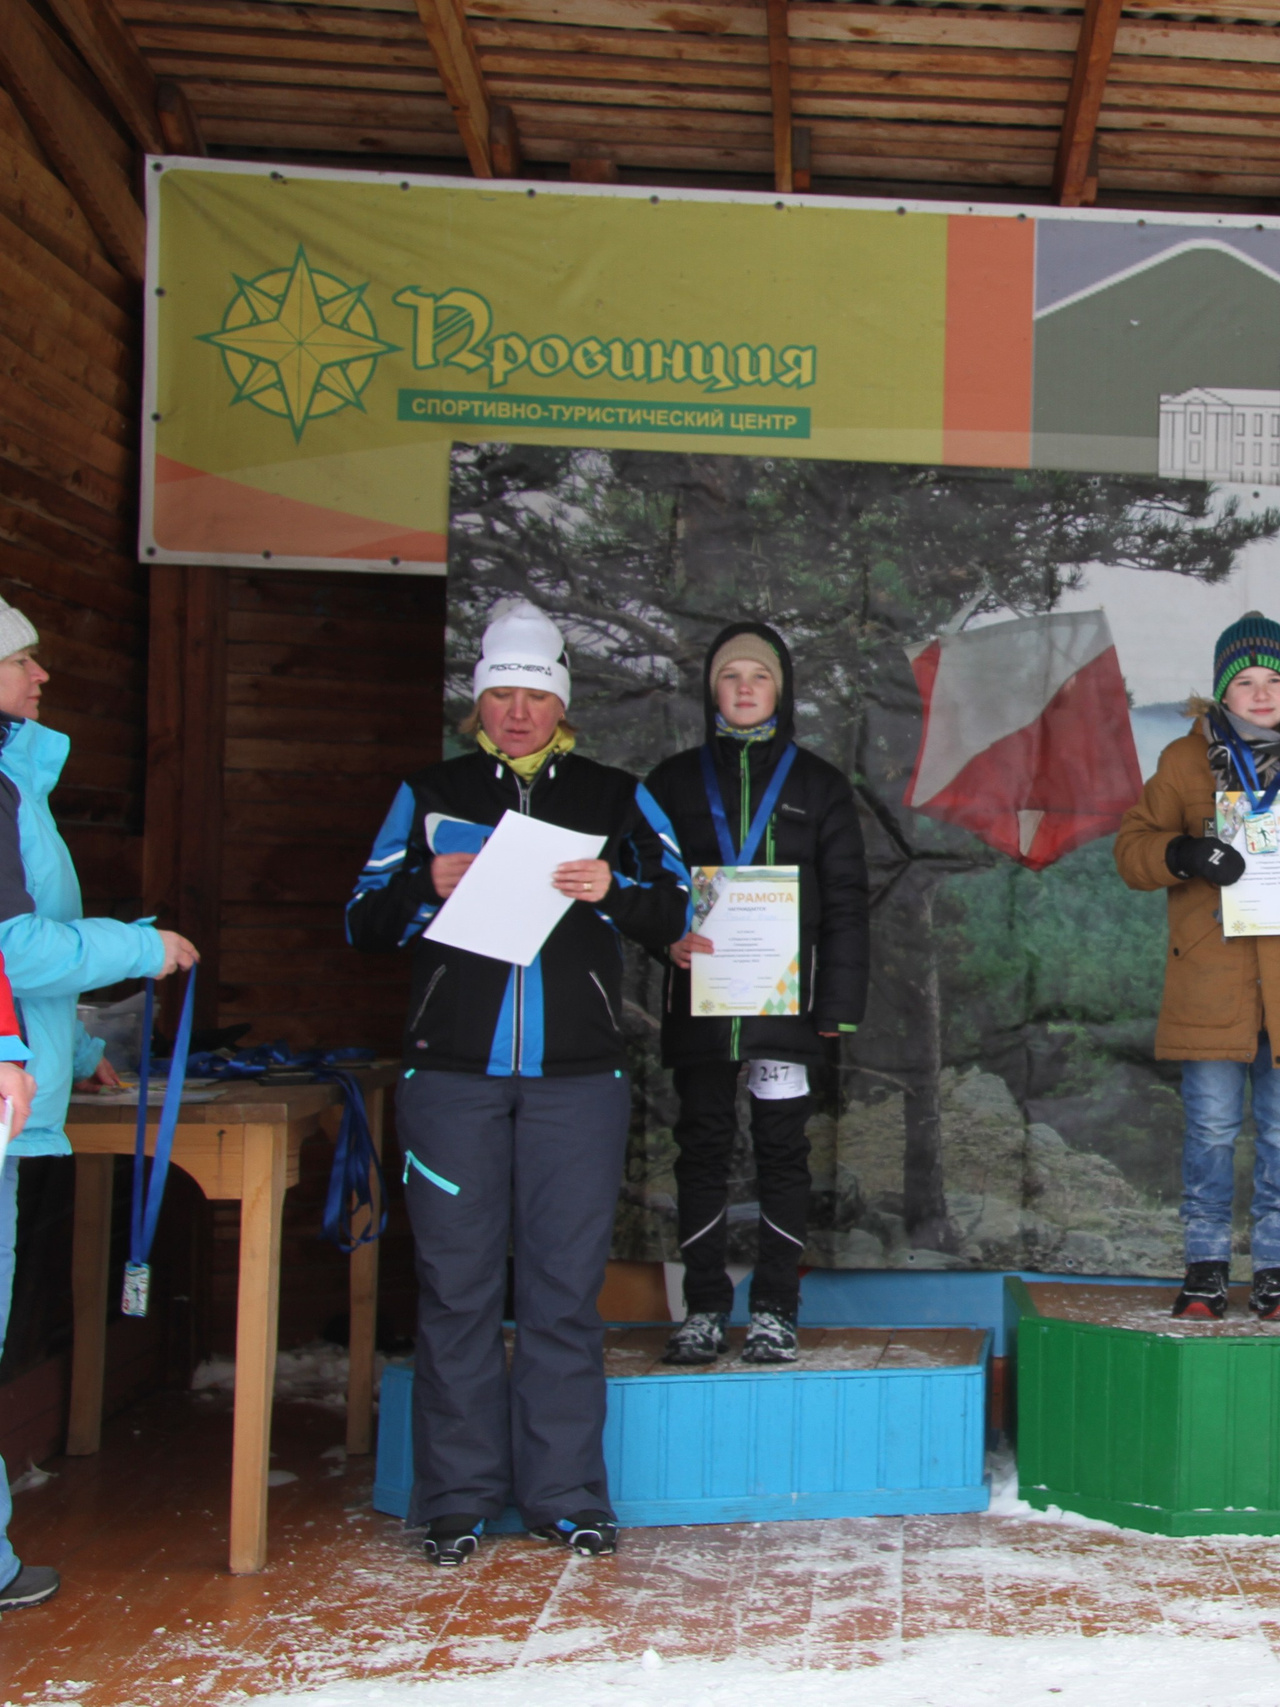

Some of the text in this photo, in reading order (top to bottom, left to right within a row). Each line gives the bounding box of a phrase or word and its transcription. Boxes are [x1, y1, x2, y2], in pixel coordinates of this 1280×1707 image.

[392, 285, 815, 392] Провинция
[411, 398, 797, 430] СПОРТИВНО-ТУРИСТИЧЕСКИЙ ЦЕНТР
[729, 892, 795, 903] ГРАМОТА
[760, 1066, 790, 1081] 247
